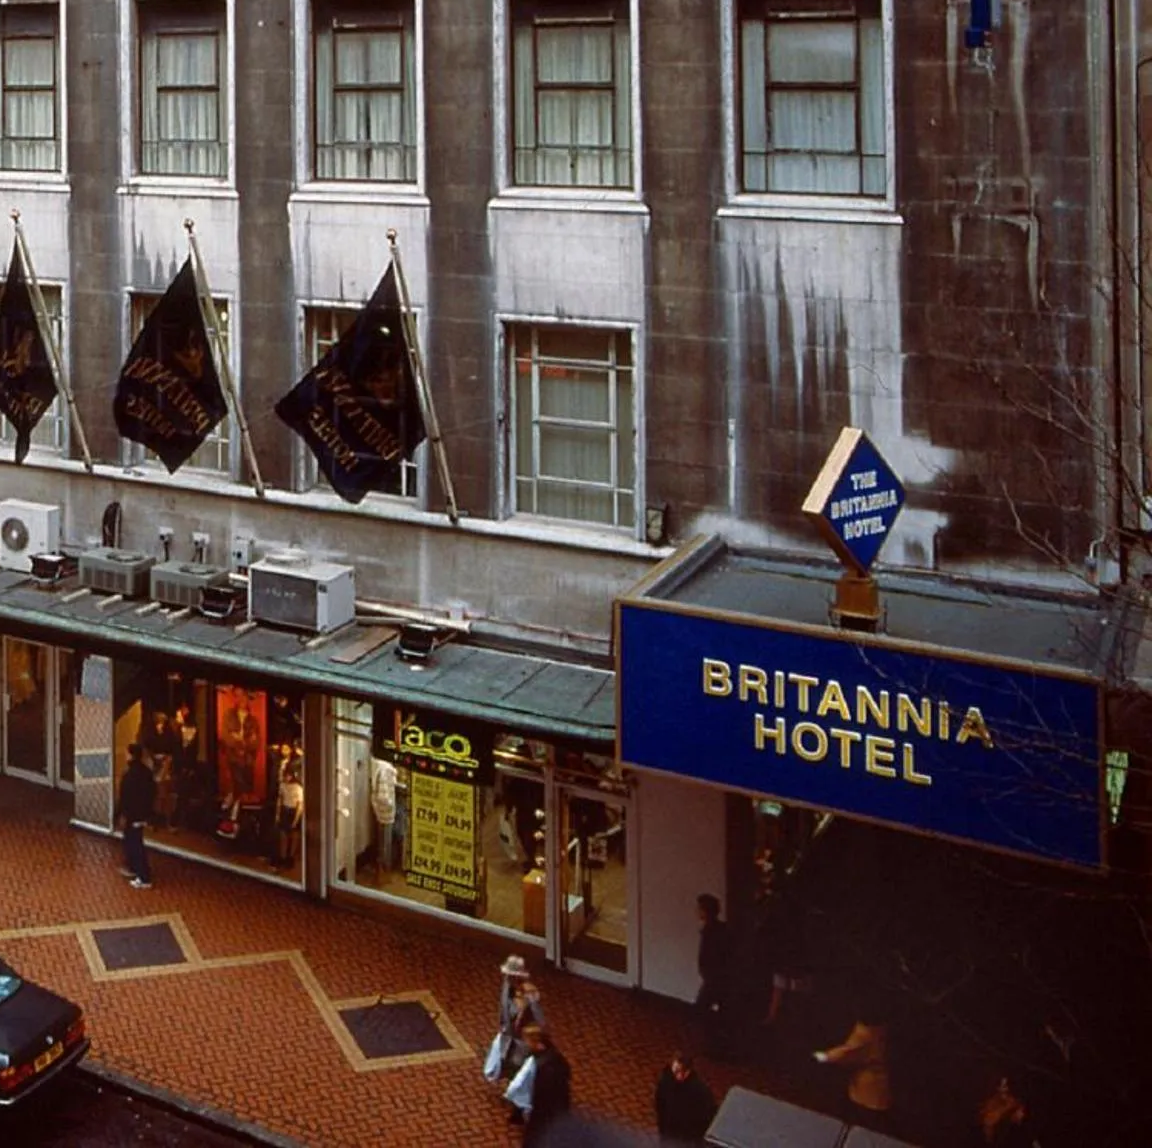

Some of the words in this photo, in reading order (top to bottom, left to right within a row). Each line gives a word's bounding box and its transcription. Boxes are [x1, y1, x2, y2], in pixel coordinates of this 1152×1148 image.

[850, 470, 878, 490] THE
[830, 489, 898, 520] BRITANNIA
[843, 516, 887, 541] HOTEL
[702, 656, 994, 749] BRITANNIA
[754, 713, 933, 786] HOTEL
